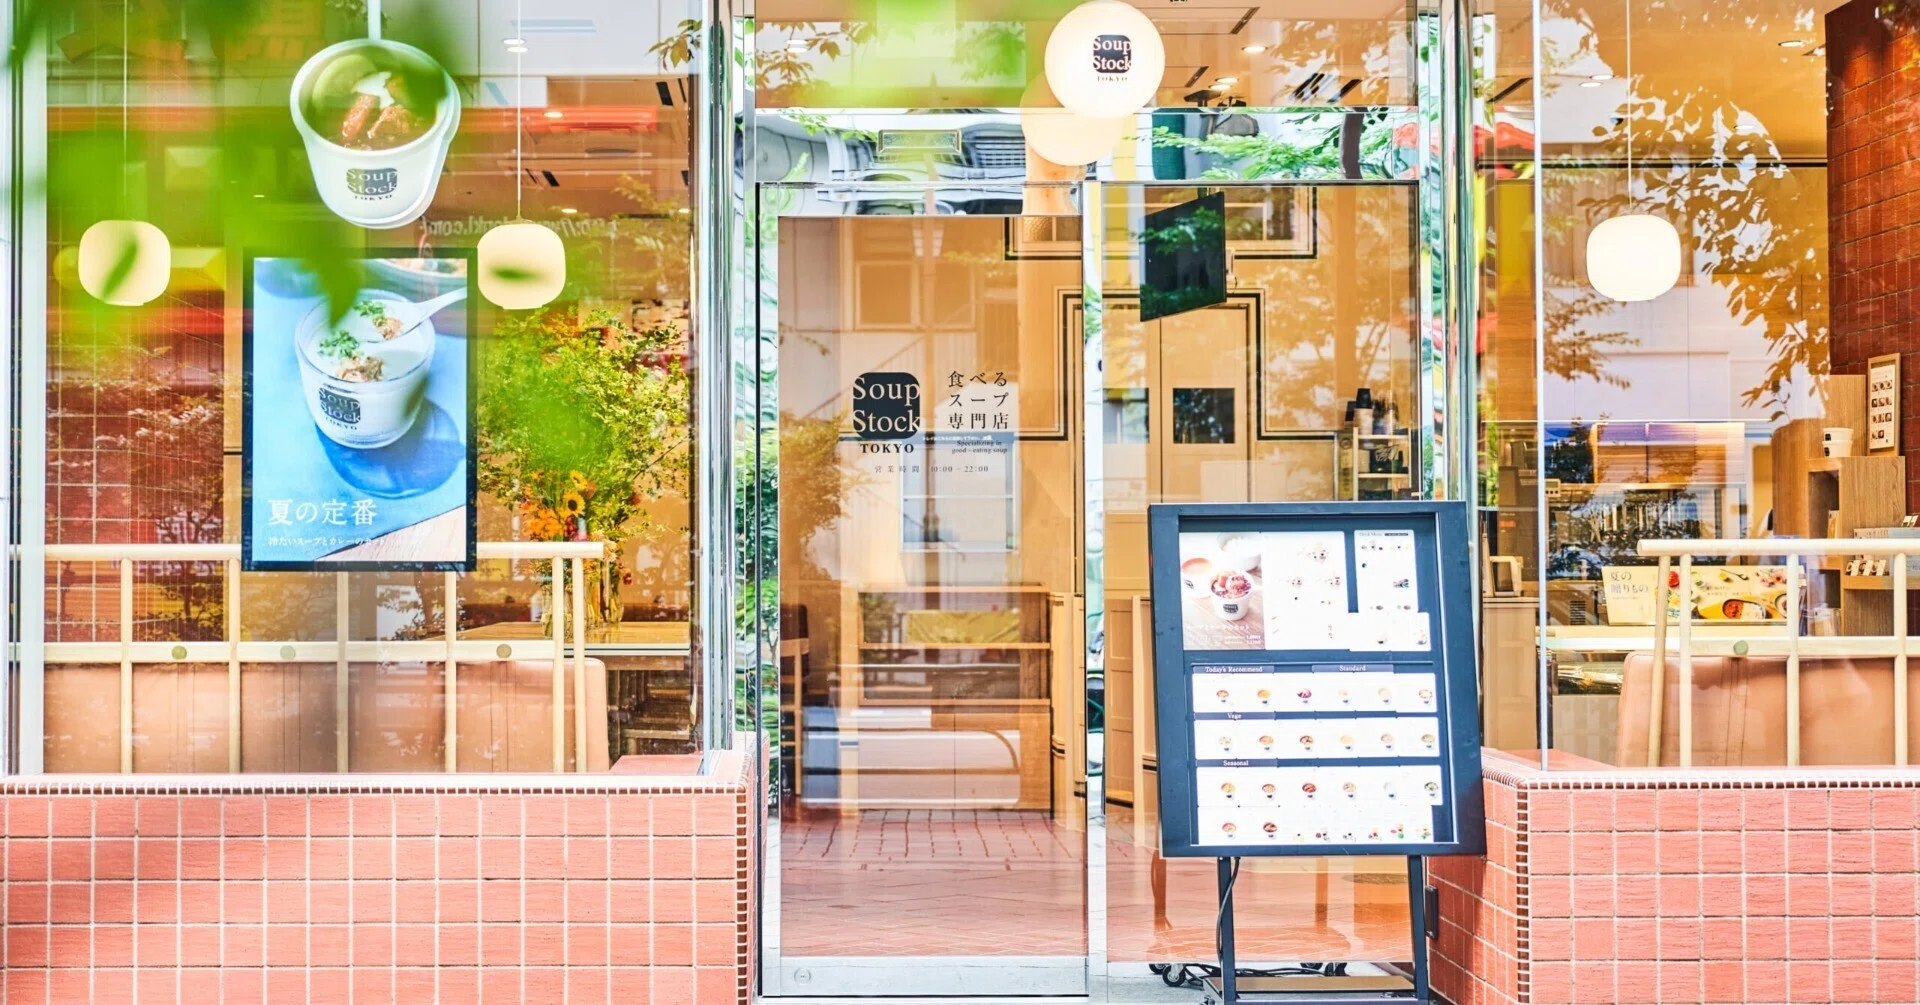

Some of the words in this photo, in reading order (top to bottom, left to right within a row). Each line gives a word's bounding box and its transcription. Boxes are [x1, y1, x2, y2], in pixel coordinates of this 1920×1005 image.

[1092, 36, 1131, 55] Soup
[1092, 55, 1131, 71] Stock
[346, 171, 397, 182] Soup
[347, 182, 397, 194] Stock
[947, 370, 1008, 388] 食べる
[853, 376, 920, 407] Soup
[319, 388, 360, 411] Soup
[948, 391, 1009, 408] スープ
[320, 400, 361, 423] Stock
[853, 409, 920, 433] Stock
[947, 411, 1009, 430] 専門店
[860, 443, 915, 454] TOKYO
[956, 439, 994, 447] Specializing
[952, 447, 967, 455] good
[973, 447, 991, 455] eating
[993, 447, 1008, 455] soup
[874, 464, 920, 474] 営業時間
[930, 465, 953, 473] 10:00
[964, 465, 989, 473] 22:00
[267, 498, 378, 527] 夏の定番
[1610, 571, 1632, 582] 夏の
[1610, 583, 1649, 594] 贈りもの
[1205, 665, 1226, 673] Today's
[1228, 665, 1263, 673] Recommend
[1226, 712, 1242, 720] Vege
